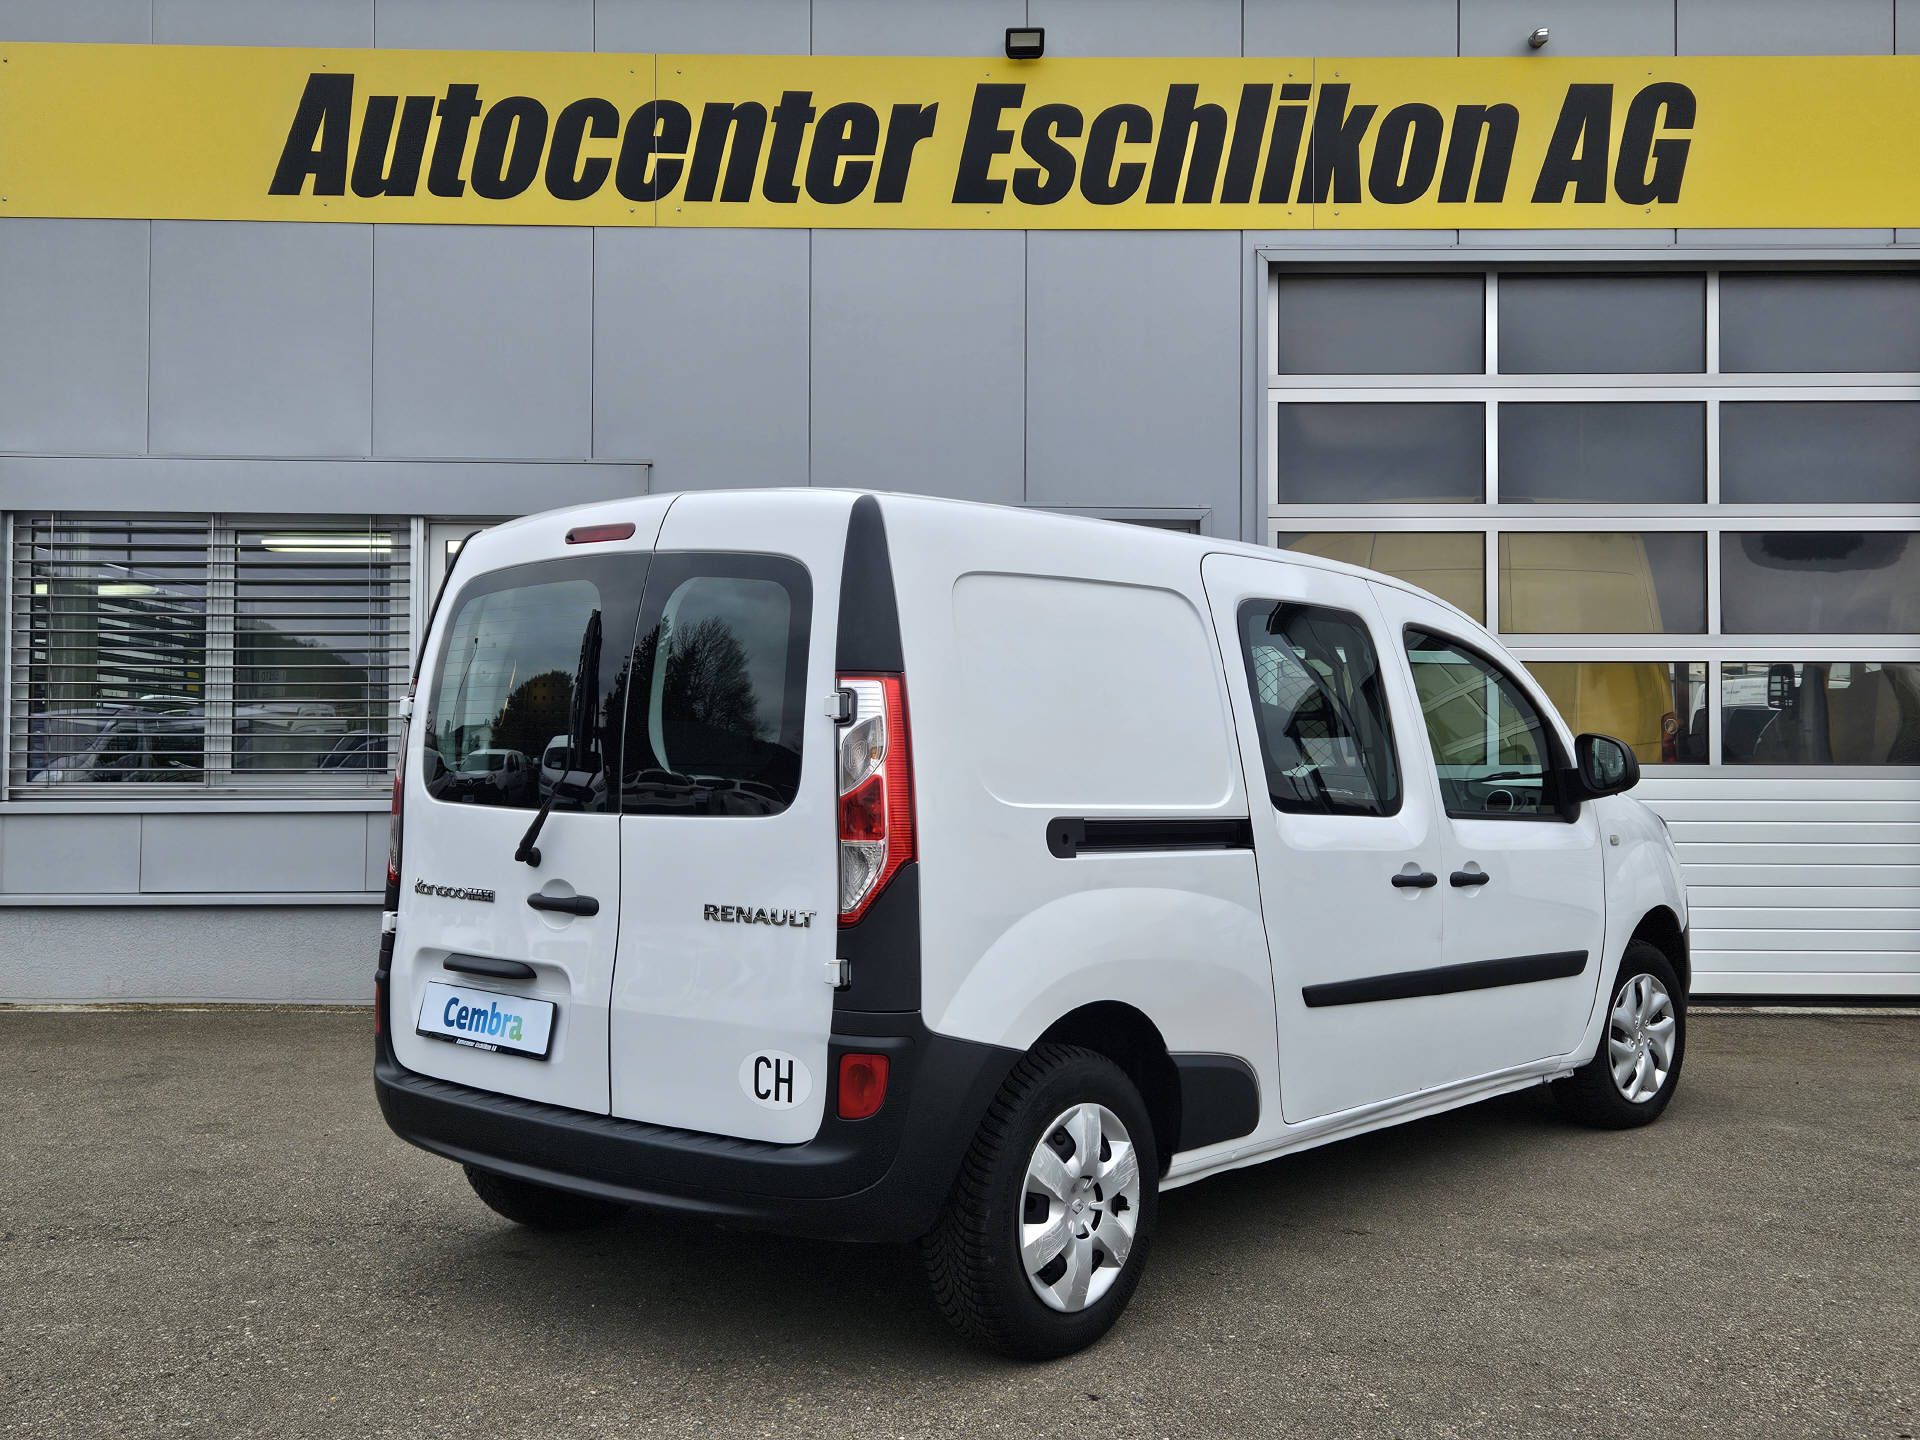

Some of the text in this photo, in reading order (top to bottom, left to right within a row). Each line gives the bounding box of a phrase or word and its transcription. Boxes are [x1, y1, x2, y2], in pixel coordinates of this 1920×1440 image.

[269, 73, 1697, 205] Autocenter Eschlikon AG
[703, 903, 817, 928] RENAULT
[443, 996, 523, 1042] Cembra
[754, 1055, 794, 1103] CH
